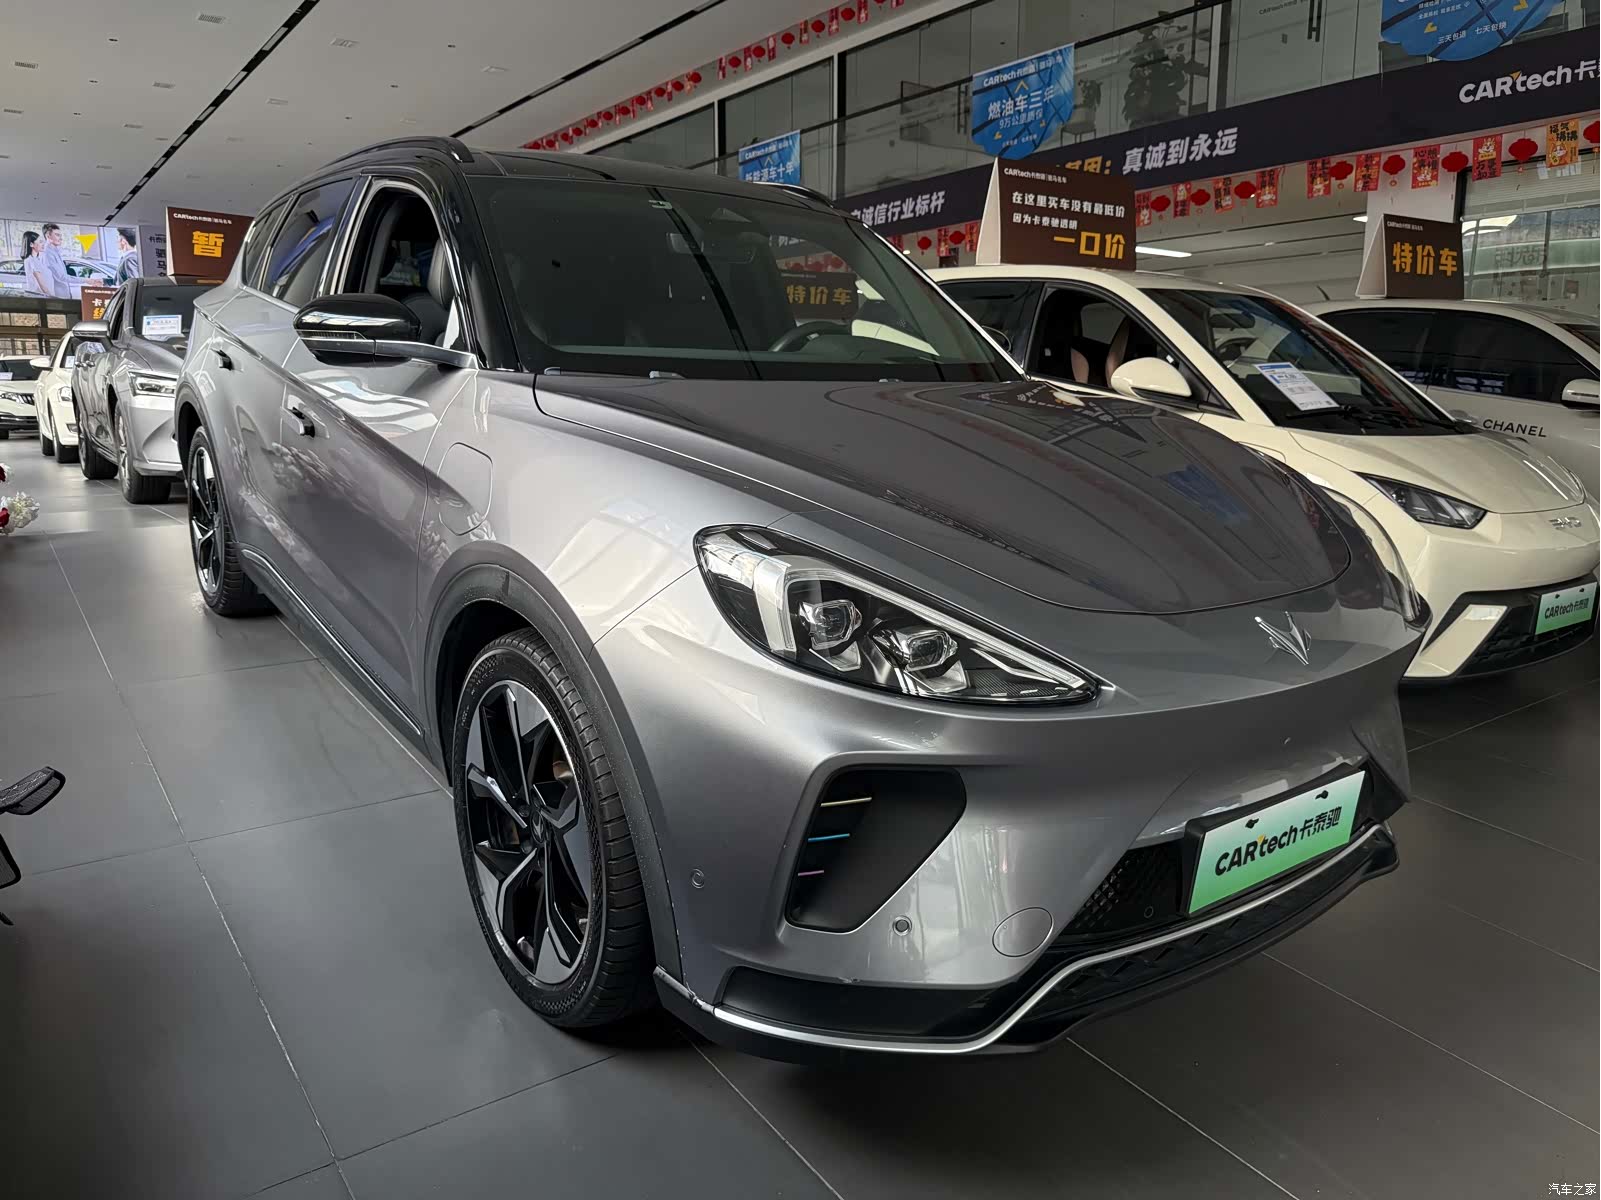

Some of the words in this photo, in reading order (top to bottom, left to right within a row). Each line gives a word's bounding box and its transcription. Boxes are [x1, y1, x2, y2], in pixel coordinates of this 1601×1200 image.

[1459, 60, 1600, 104] CARtech卡
[987, 84, 1056, 121] 燃油车三年
[1122, 127, 1239, 175] 真诚到永远
[1012, 191, 1126, 219] 在这里买车没有最低价
[1012, 212, 1078, 231] 因为卡泰驰透明
[192, 230, 225, 259] 暂
[1053, 230, 1126, 260] 一口价
[1392, 241, 1458, 277] 特价车
[786, 284, 852, 305] 特价车
[1482, 418, 1547, 438] CHANEL
[1214, 805, 1343, 876] CARtech卡泰驰
